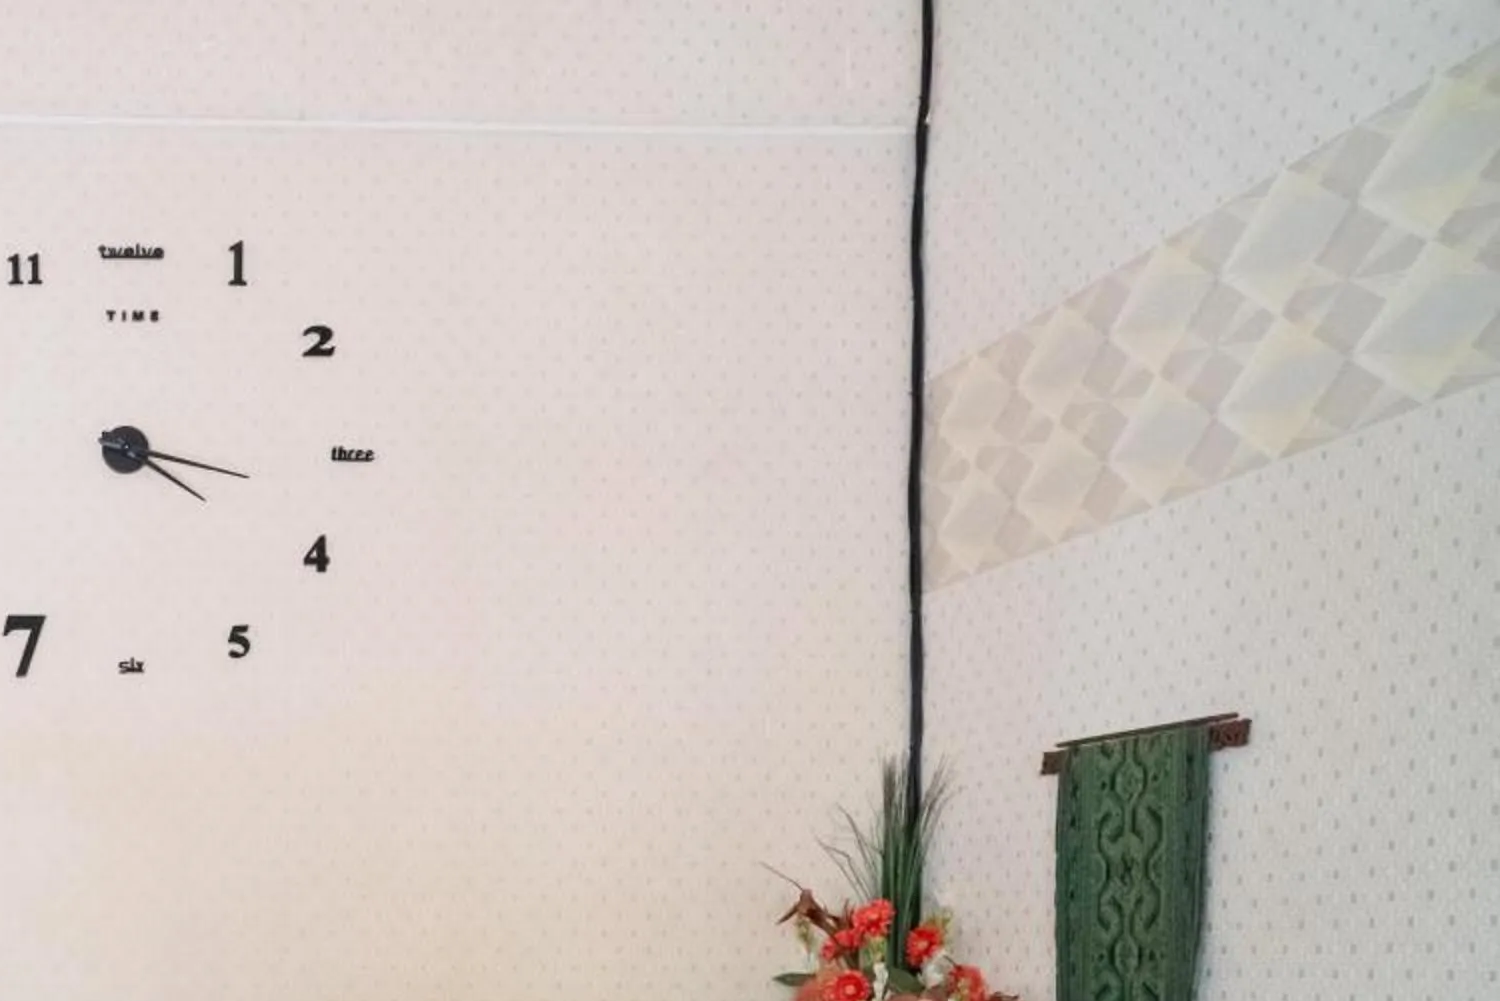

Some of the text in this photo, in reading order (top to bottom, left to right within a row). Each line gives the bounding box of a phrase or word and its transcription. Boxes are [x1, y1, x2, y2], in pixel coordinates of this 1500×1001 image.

[98, 244, 165, 260] twelve
[227, 240, 248, 287] 1
[7, 252, 43, 286] 11
[105, 309, 160, 323] TIME
[302, 325, 336, 358] 2
[330, 445, 375, 463] three
[303, 534, 331, 573] 4
[2, 614, 47, 678] 7
[227, 624, 251, 659] 5
[118, 657, 145, 675] six
